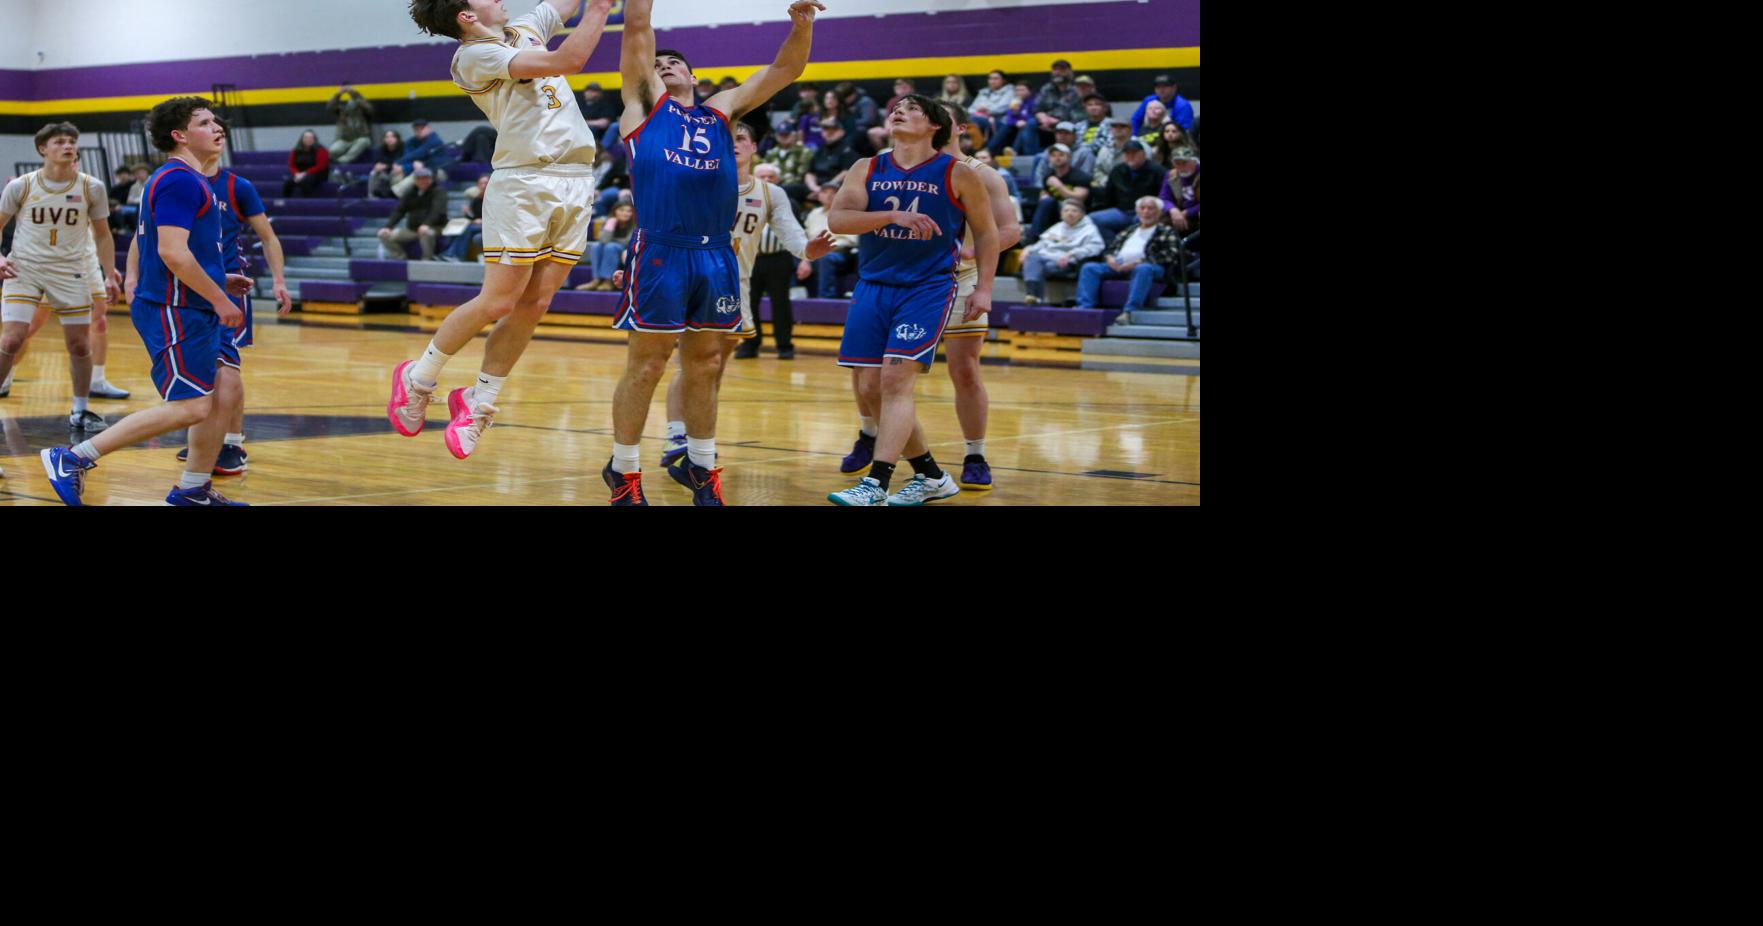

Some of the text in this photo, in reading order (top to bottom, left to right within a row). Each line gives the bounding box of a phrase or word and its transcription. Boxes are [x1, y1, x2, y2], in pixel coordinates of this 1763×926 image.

[541, 85, 561, 110] 3
[677, 124, 711, 154] 15
[872, 181, 939, 195] POWDER
[32, 207, 79, 225] UVC
[730, 212, 758, 234] VC
[49, 229, 58, 246] 1
[873, 228, 918, 240] VALLE
